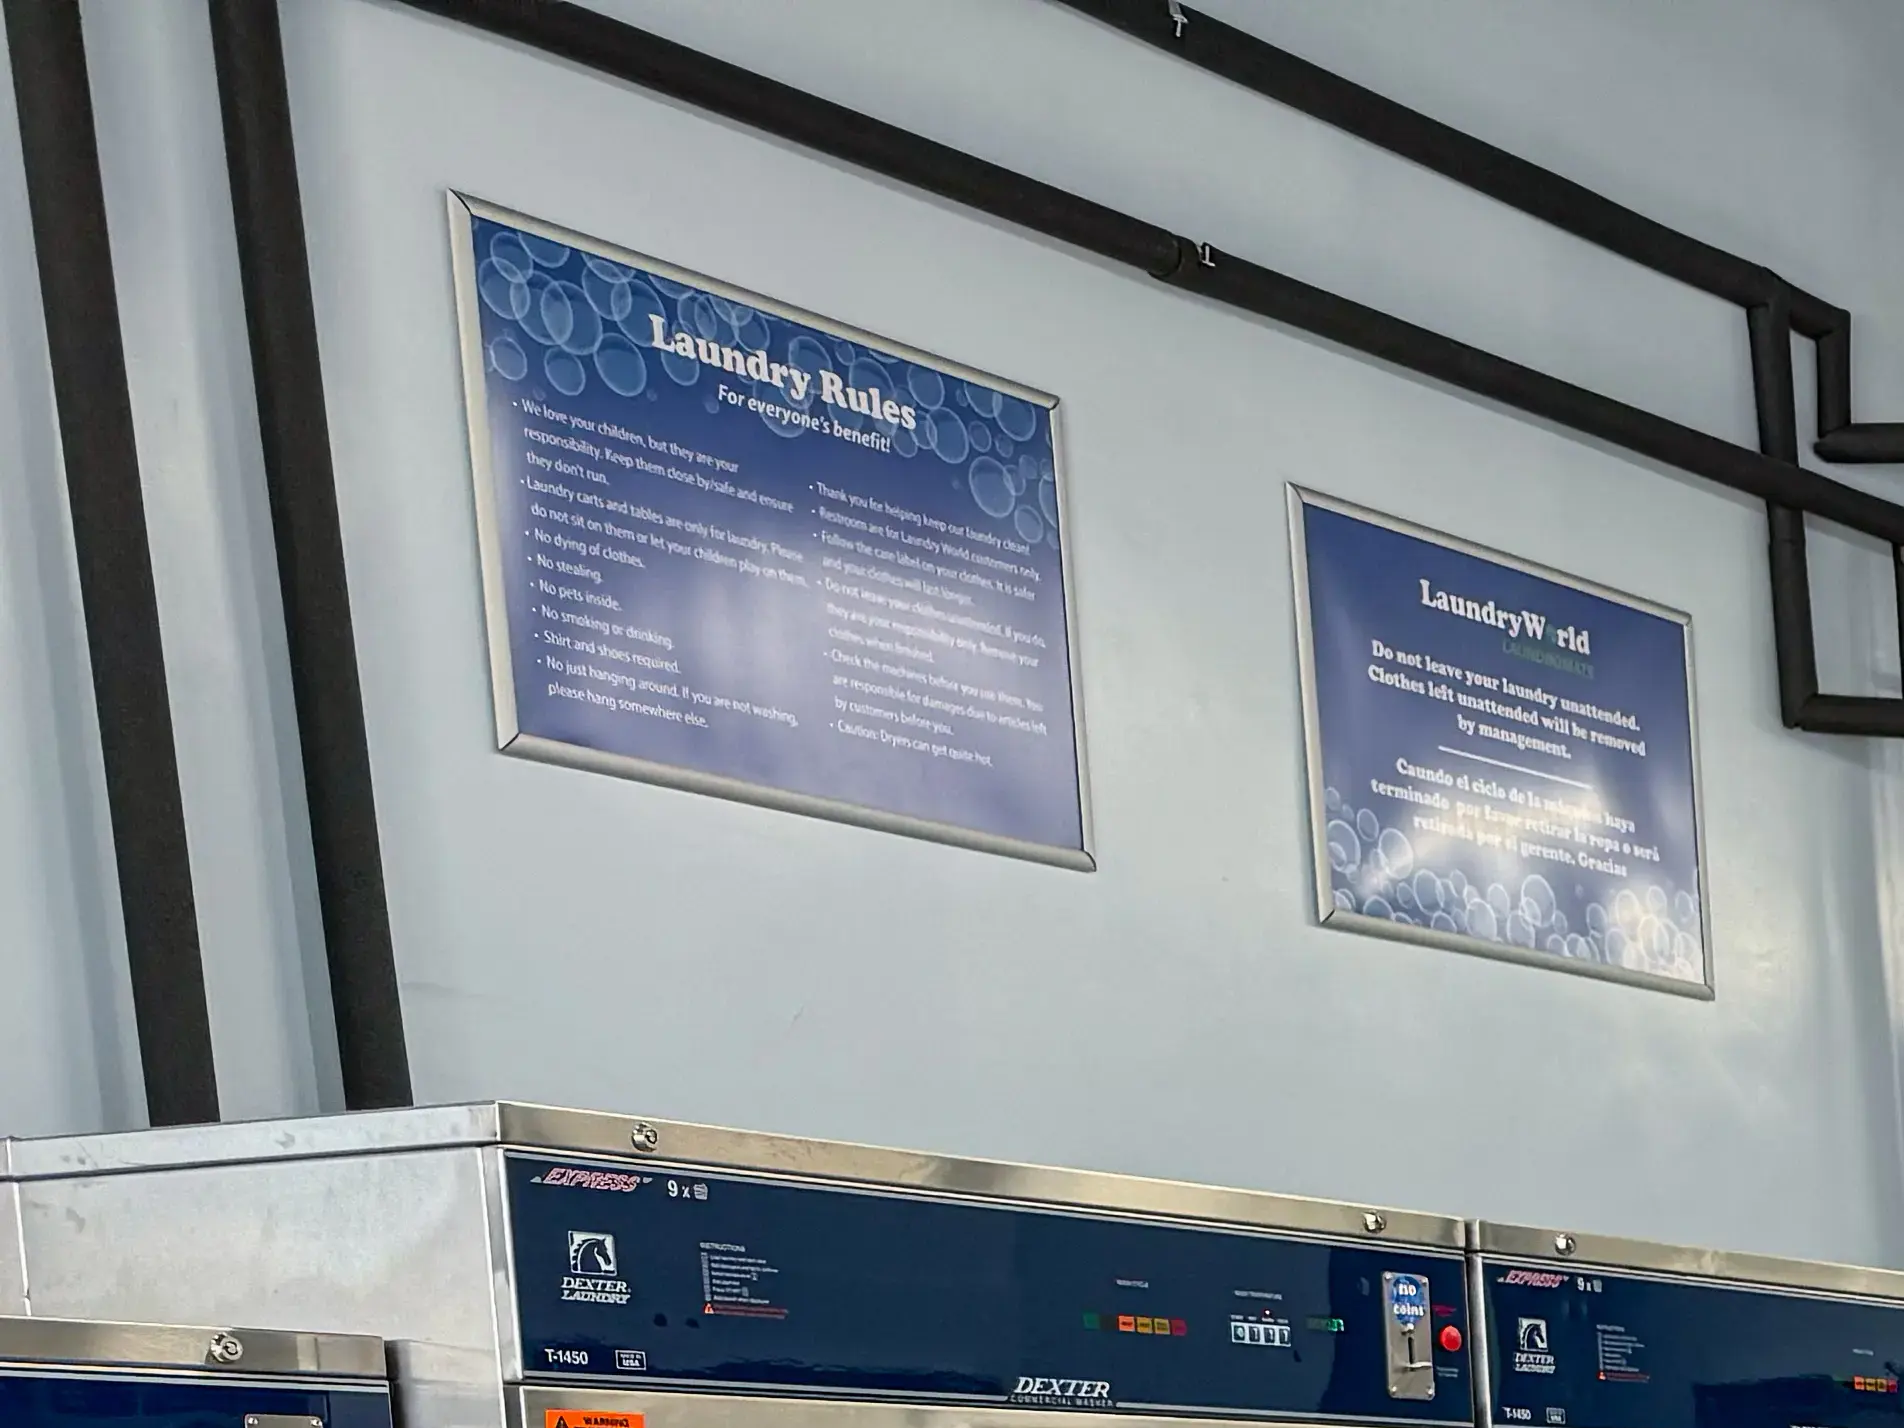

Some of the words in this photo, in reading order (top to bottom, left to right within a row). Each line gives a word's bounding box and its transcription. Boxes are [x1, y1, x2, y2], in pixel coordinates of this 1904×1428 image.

[649, 314, 813, 404] Laundry
[819, 370, 916, 439] Rules
[521, 398, 542, 417] We
[542, 404, 568, 425] love
[569, 415, 595, 432] your
[597, 422, 647, 448] children,
[647, 435, 669, 454] but
[669, 442, 695, 463] they
[695, 451, 715, 467] are
[713, 457, 739, 473] your
[718, 383, 745, 407] For
[747, 398, 830, 434] everyone's
[831, 417, 891, 453] benefit!
[526, 450, 553, 472] they
[554, 458, 585, 479] don't
[586, 469, 610, 485] run.
[534, 527, 552, 544] No
[553, 533, 587, 556] dying
[588, 542, 601, 556] of
[602, 546, 645, 568] clothes.
[536, 553, 554, 570] No
[555, 560, 602, 584] stealing.
[539, 579, 557, 596] No
[558, 586, 584, 602] pets
[585, 590, 622, 611] inside.
[541, 604, 560, 620] No
[560, 611, 610, 635] smoking
[611, 624, 624, 636] or
[625, 625, 674, 651] drinking.
[543, 629, 572, 649] Shirt
[573, 639, 596, 654] and
[596, 643, 631, 663] shoes
[631, 654, 681, 674] required.
[546, 654, 564, 672] No
[565, 660, 587, 677] just
[588, 664, 636, 692] hanging
[638, 680, 680, 698] around.
[691, 692, 712, 705] you
[713, 696, 732, 710] are
[732, 700, 751, 715] not
[752, 705, 799, 728] washing,
[548, 681, 586, 701] please
[586, 688, 617, 711] hang
[618, 699, 683, 722] somewhere
[684, 711, 709, 728] else.
[1371, 639, 1394, 660] Do
[1396, 651, 1423, 669] not
[1424, 655, 1463, 680] leave
[1464, 670, 1500, 691] your
[1502, 677, 1558, 710] laundry
[1560, 698, 1640, 731] unattended.
[1368, 664, 1426, 695] Clothes
[1427, 680, 1455, 703] left
[1457, 692, 1539, 726] unattended
[1540, 716, 1570, 735] will
[1571, 721, 1588, 740] be
[1590, 730, 1646, 757] removed
[1456, 713, 1476, 736] by
[1478, 724, 1571, 759] management.
[1396, 757, 1453, 786] Caundo
[1456, 774, 1470, 791] el
[1471, 778, 1506, 799] ciclo
[1508, 787, 1525, 804] de
[1526, 790, 1540, 808] la
[1520, 842, 1576, 866] gerente.
[1577, 851, 1627, 877] Gracias
[542, 1167, 643, 1192] EXPRESS
[666, 1179, 678, 1198] 9
[561, 1276, 629, 1294] DEXTER
[1397, 1282, 1417, 1297] no
[544, 1348, 589, 1366] T-1450
[1013, 1376, 1111, 1399] DEXTER
